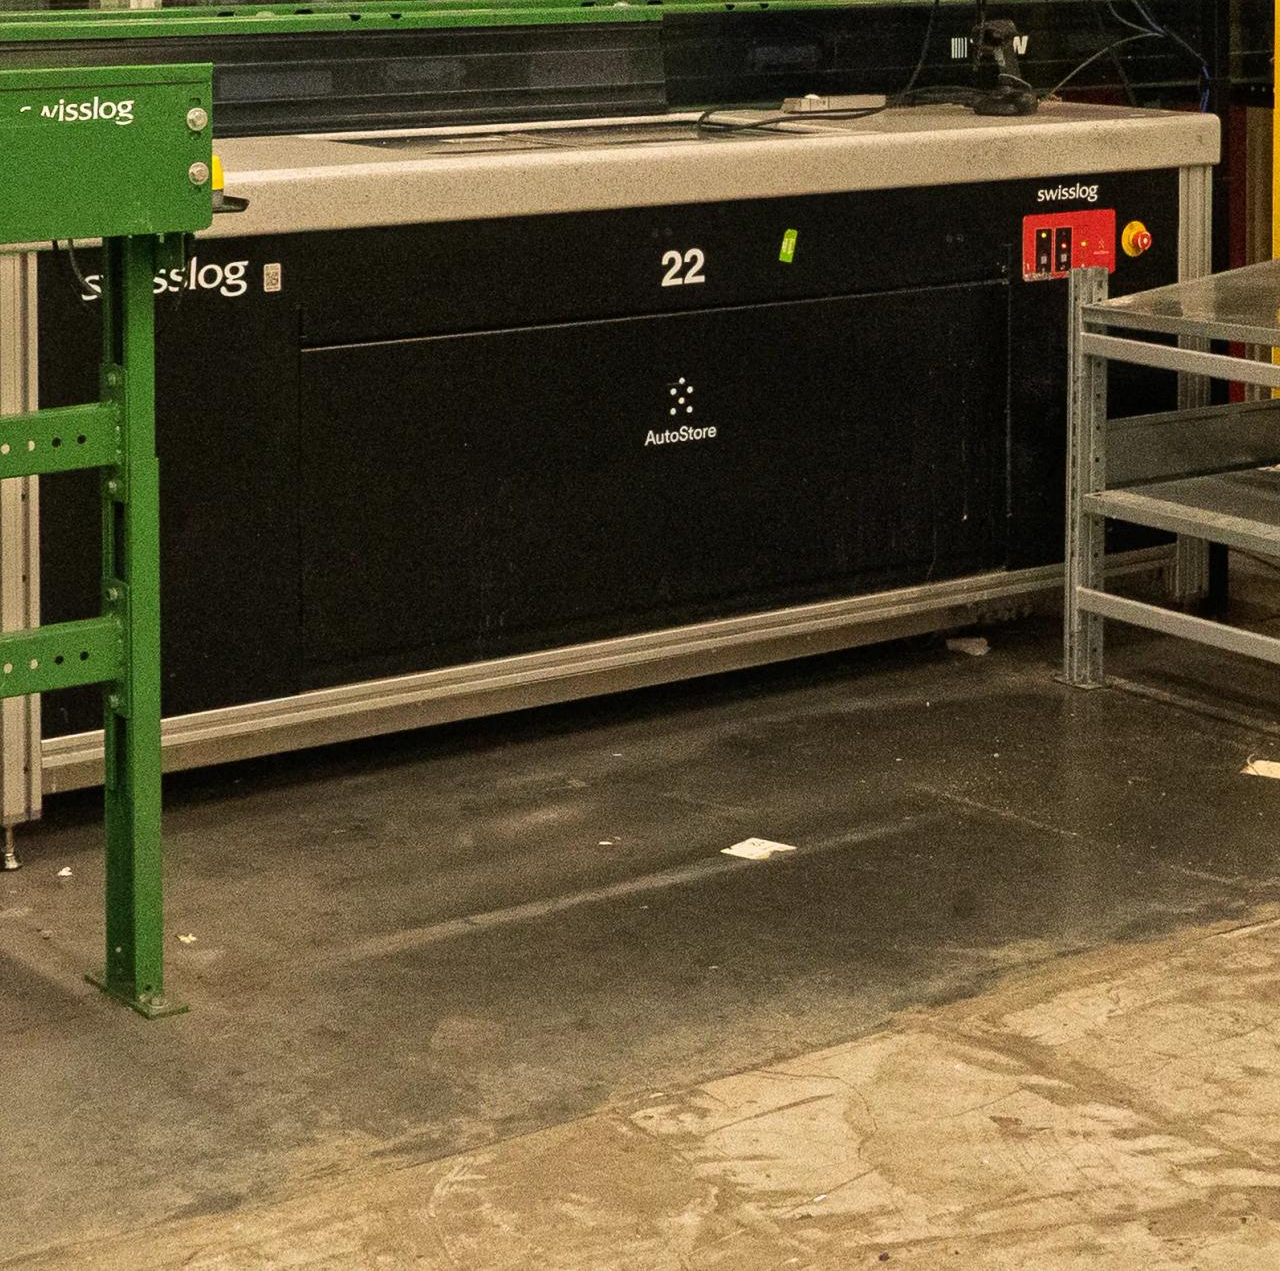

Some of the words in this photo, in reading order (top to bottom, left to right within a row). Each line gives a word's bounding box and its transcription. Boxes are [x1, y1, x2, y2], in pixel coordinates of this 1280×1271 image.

[20, 96, 135, 125] wisslog
[1037, 182, 1099, 202] swisslog
[81, 256, 249, 301] ssslog
[661, 248, 705, 287] 22
[644, 425, 717, 446] AutoStore
